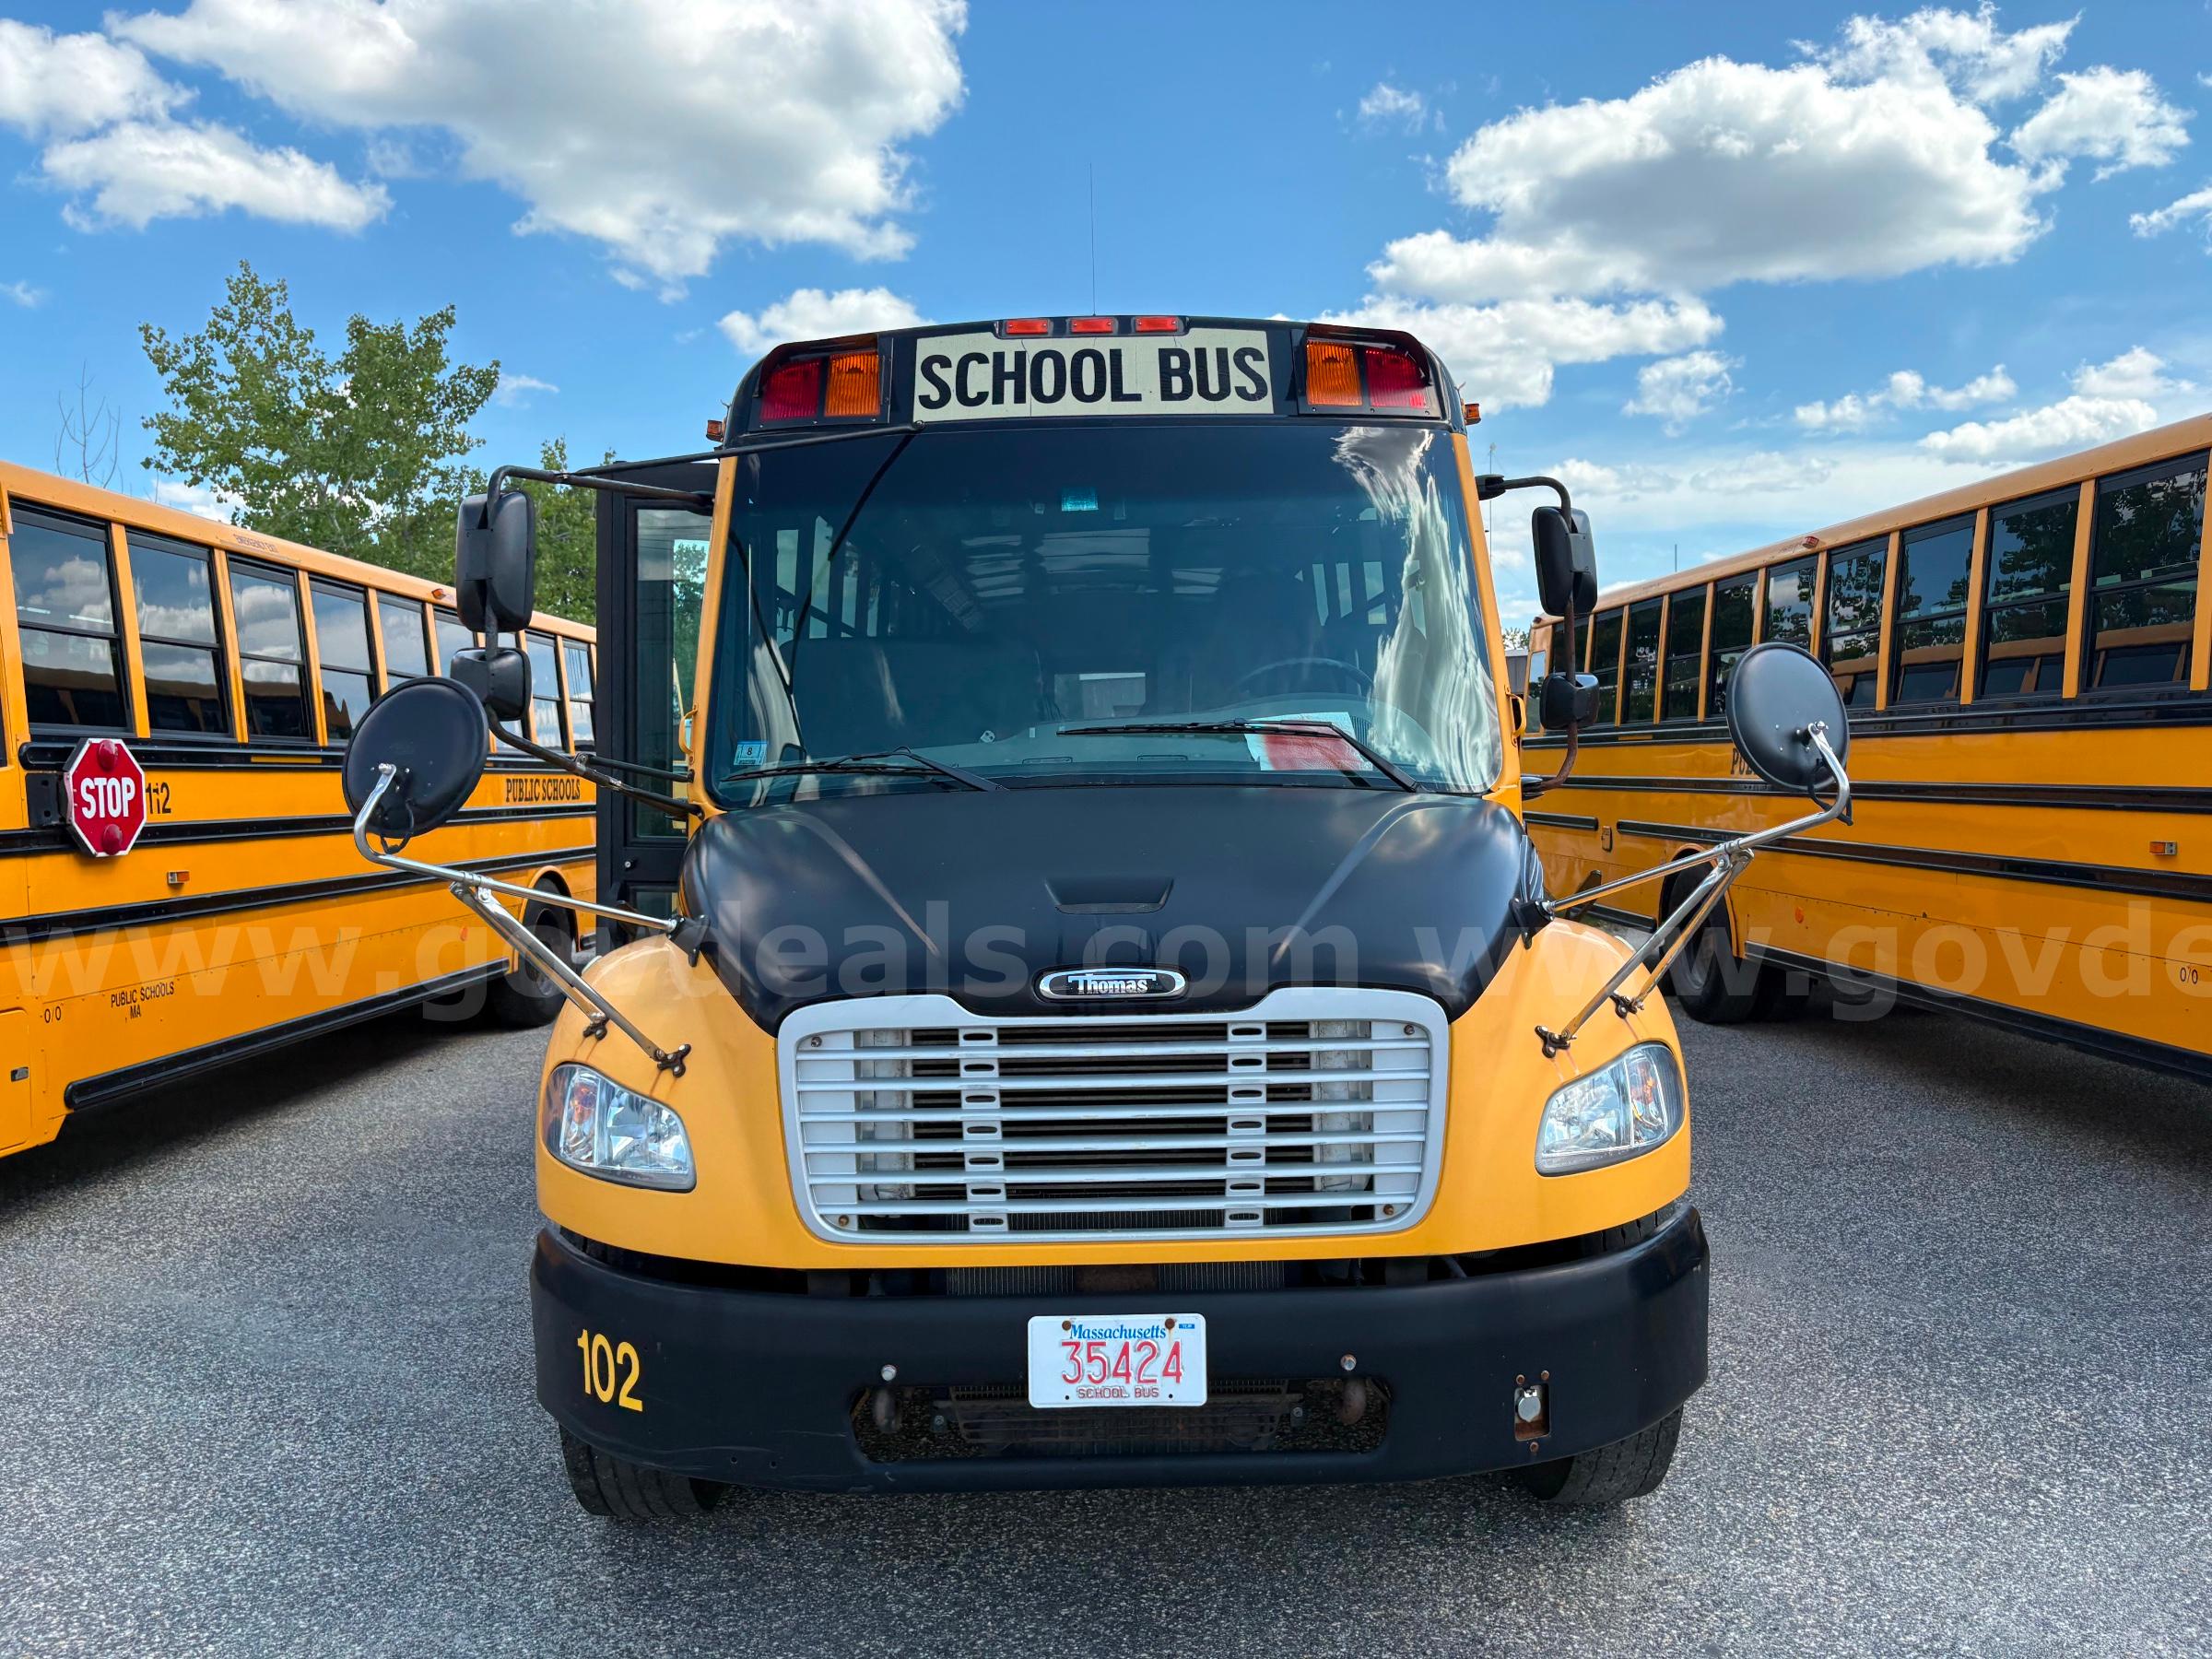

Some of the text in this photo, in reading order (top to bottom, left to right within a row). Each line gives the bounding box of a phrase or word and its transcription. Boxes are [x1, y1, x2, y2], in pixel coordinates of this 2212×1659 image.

[918, 347, 1268, 410] SCHOOL BUS
[81, 777, 135, 819] STOP
[146, 782, 171, 815] 112
[506, 778, 581, 803] PUBLIC SCHOOLS
[111, 982, 175, 1008] PUBLIC SCHOOLS
[1068, 973, 1156, 994] Thomas
[1069, 1324, 1167, 1339] Massachusetts
[577, 1328, 643, 1412] 102
[1061, 1340, 1183, 1384] 35424
[1077, 1386, 1160, 1399] SCHOOL BUS
